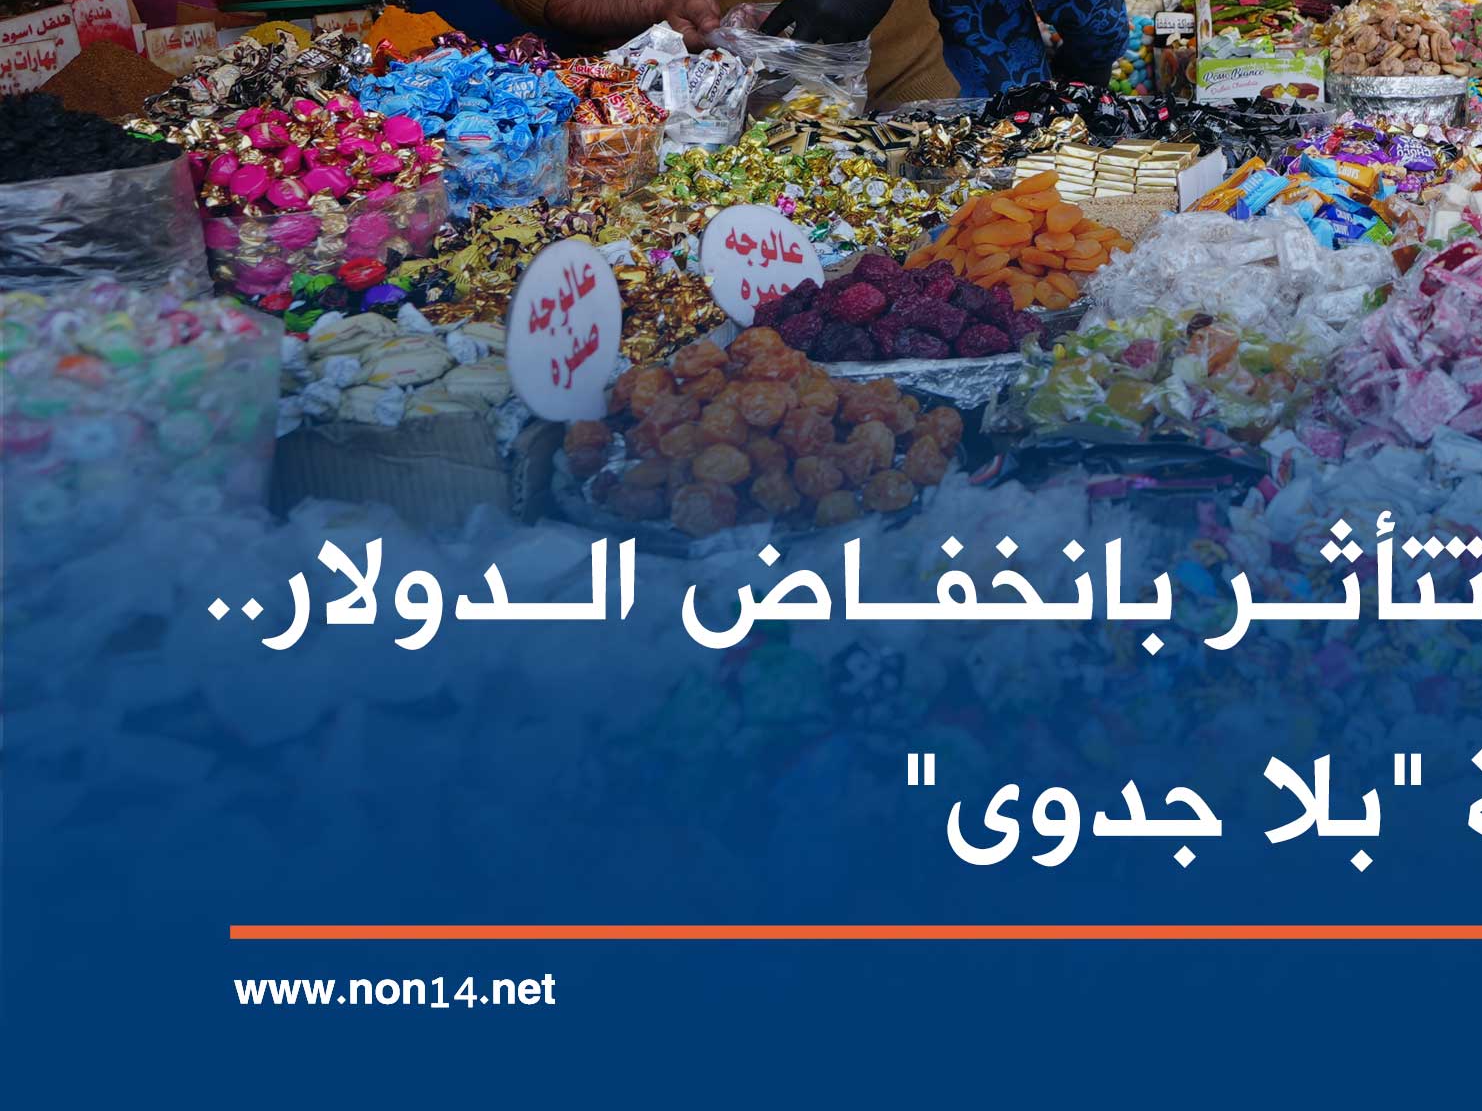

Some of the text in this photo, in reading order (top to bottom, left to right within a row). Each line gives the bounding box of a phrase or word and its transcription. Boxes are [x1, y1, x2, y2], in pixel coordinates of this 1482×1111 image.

[1, 23, 34, 44] اسود
[36, 12, 72, 36] فلفل
[13, 49, 58, 73] بهارات
[724, 226, 805, 268] عالوجه
[528, 261, 597, 336] عالوجه
[551, 321, 600, 390] صفره
